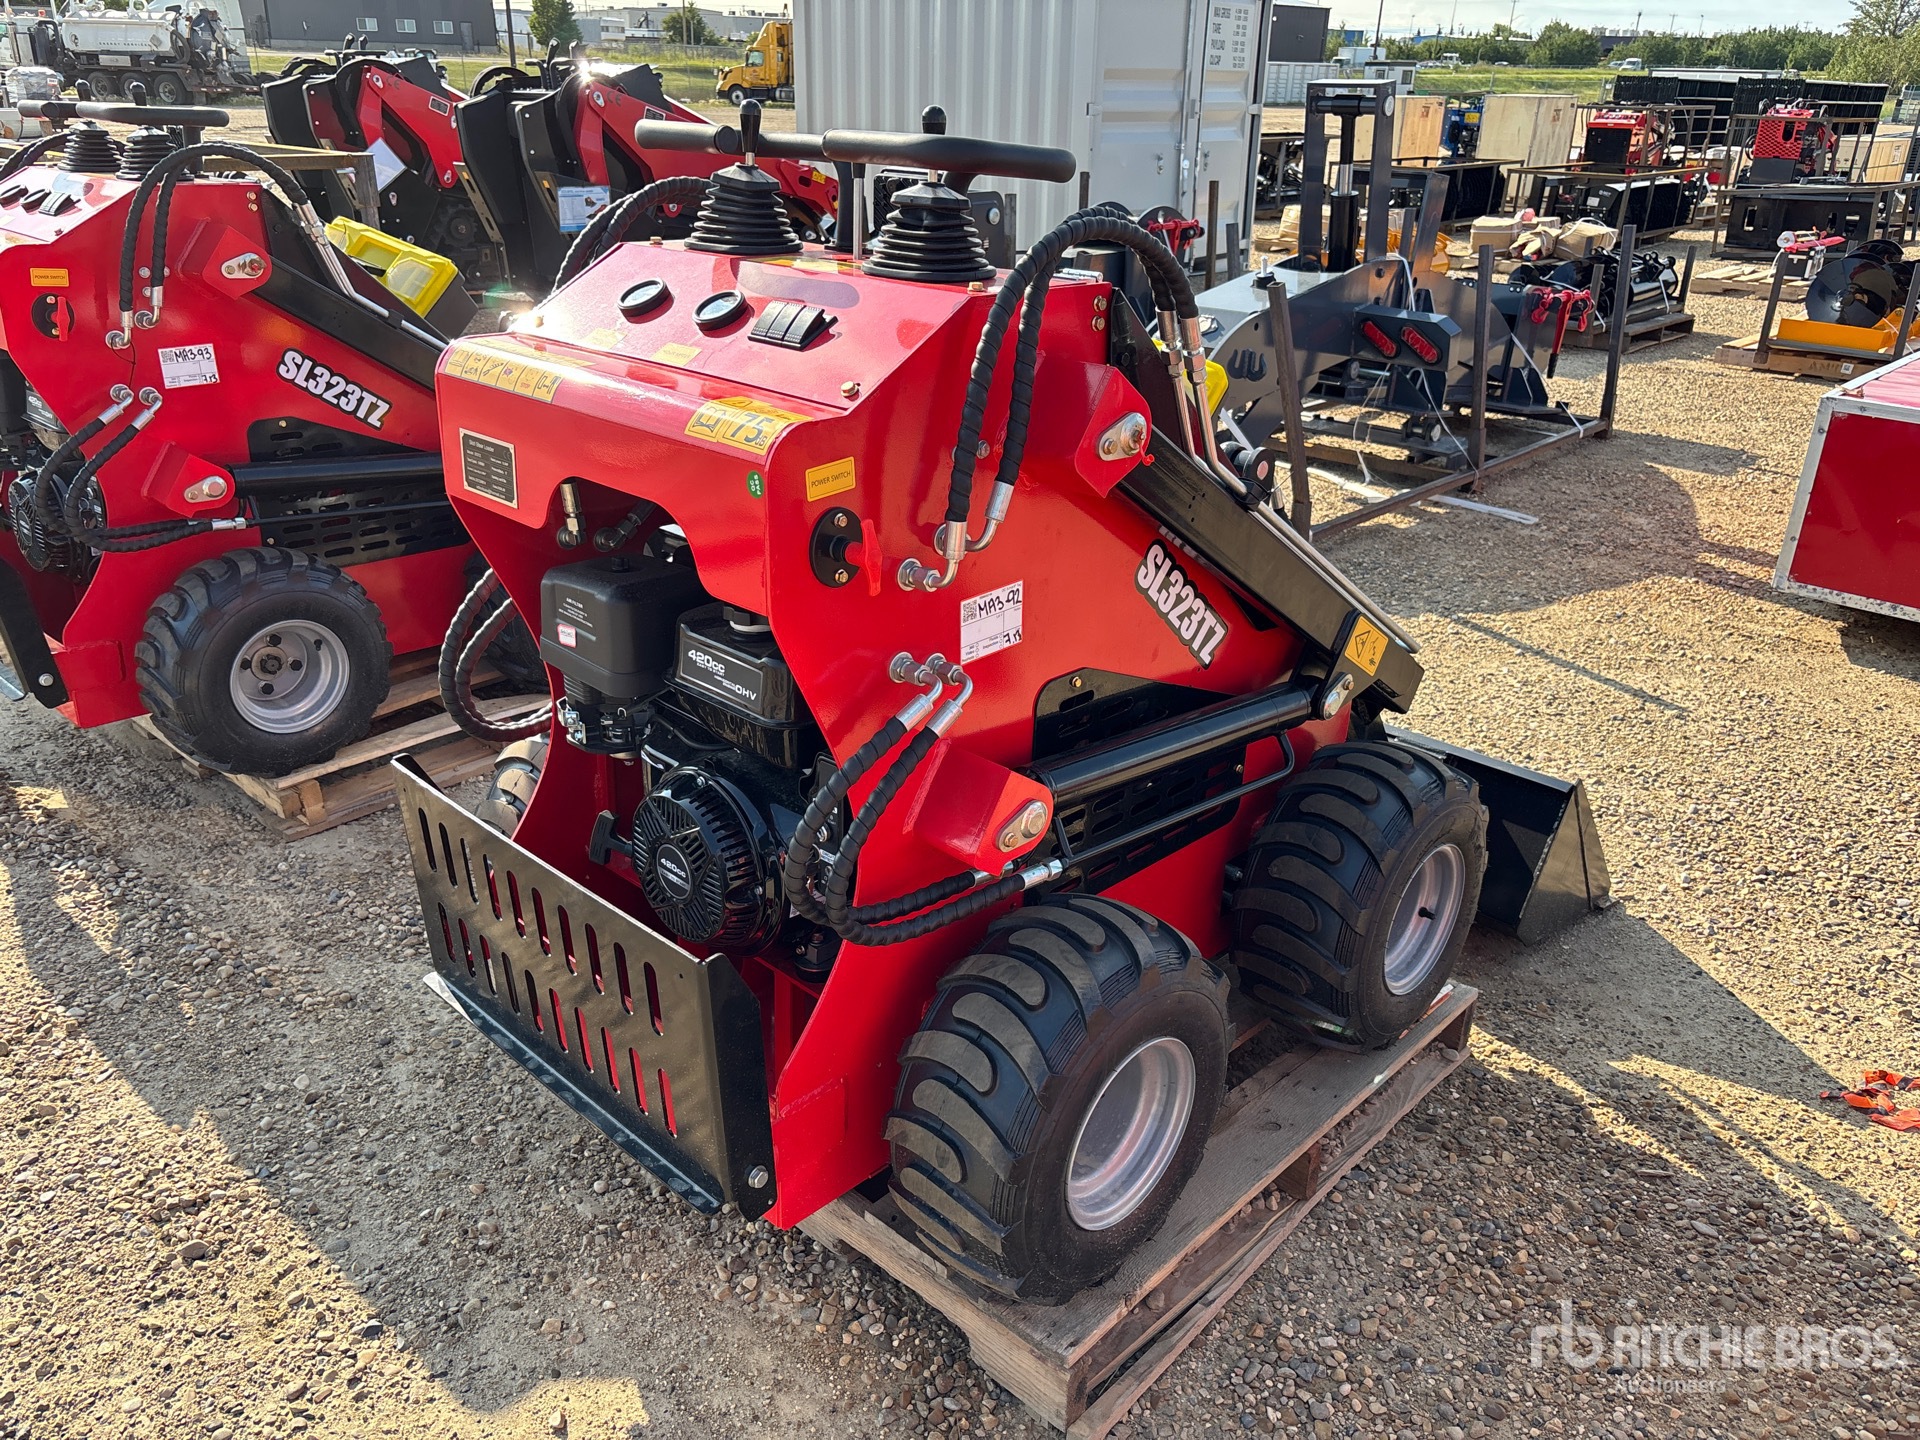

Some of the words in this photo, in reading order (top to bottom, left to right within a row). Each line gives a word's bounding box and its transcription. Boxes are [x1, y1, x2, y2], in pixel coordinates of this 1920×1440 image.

[1212, 22, 1222, 34] TARE
[278, 350, 390, 428] SL323TZ
[730, 413, 775, 443] 75
[753, 474, 762, 495] PASS
[811, 476, 830, 488] POWER
[831, 470, 851, 482] SWITCH
[977, 587, 1022, 618] MA3-92
[1137, 544, 1226, 665] SL323TZ
[688, 649, 725, 673] 420cc
[735, 685, 757, 701] OHV
[660, 858, 687, 878] 420cc
